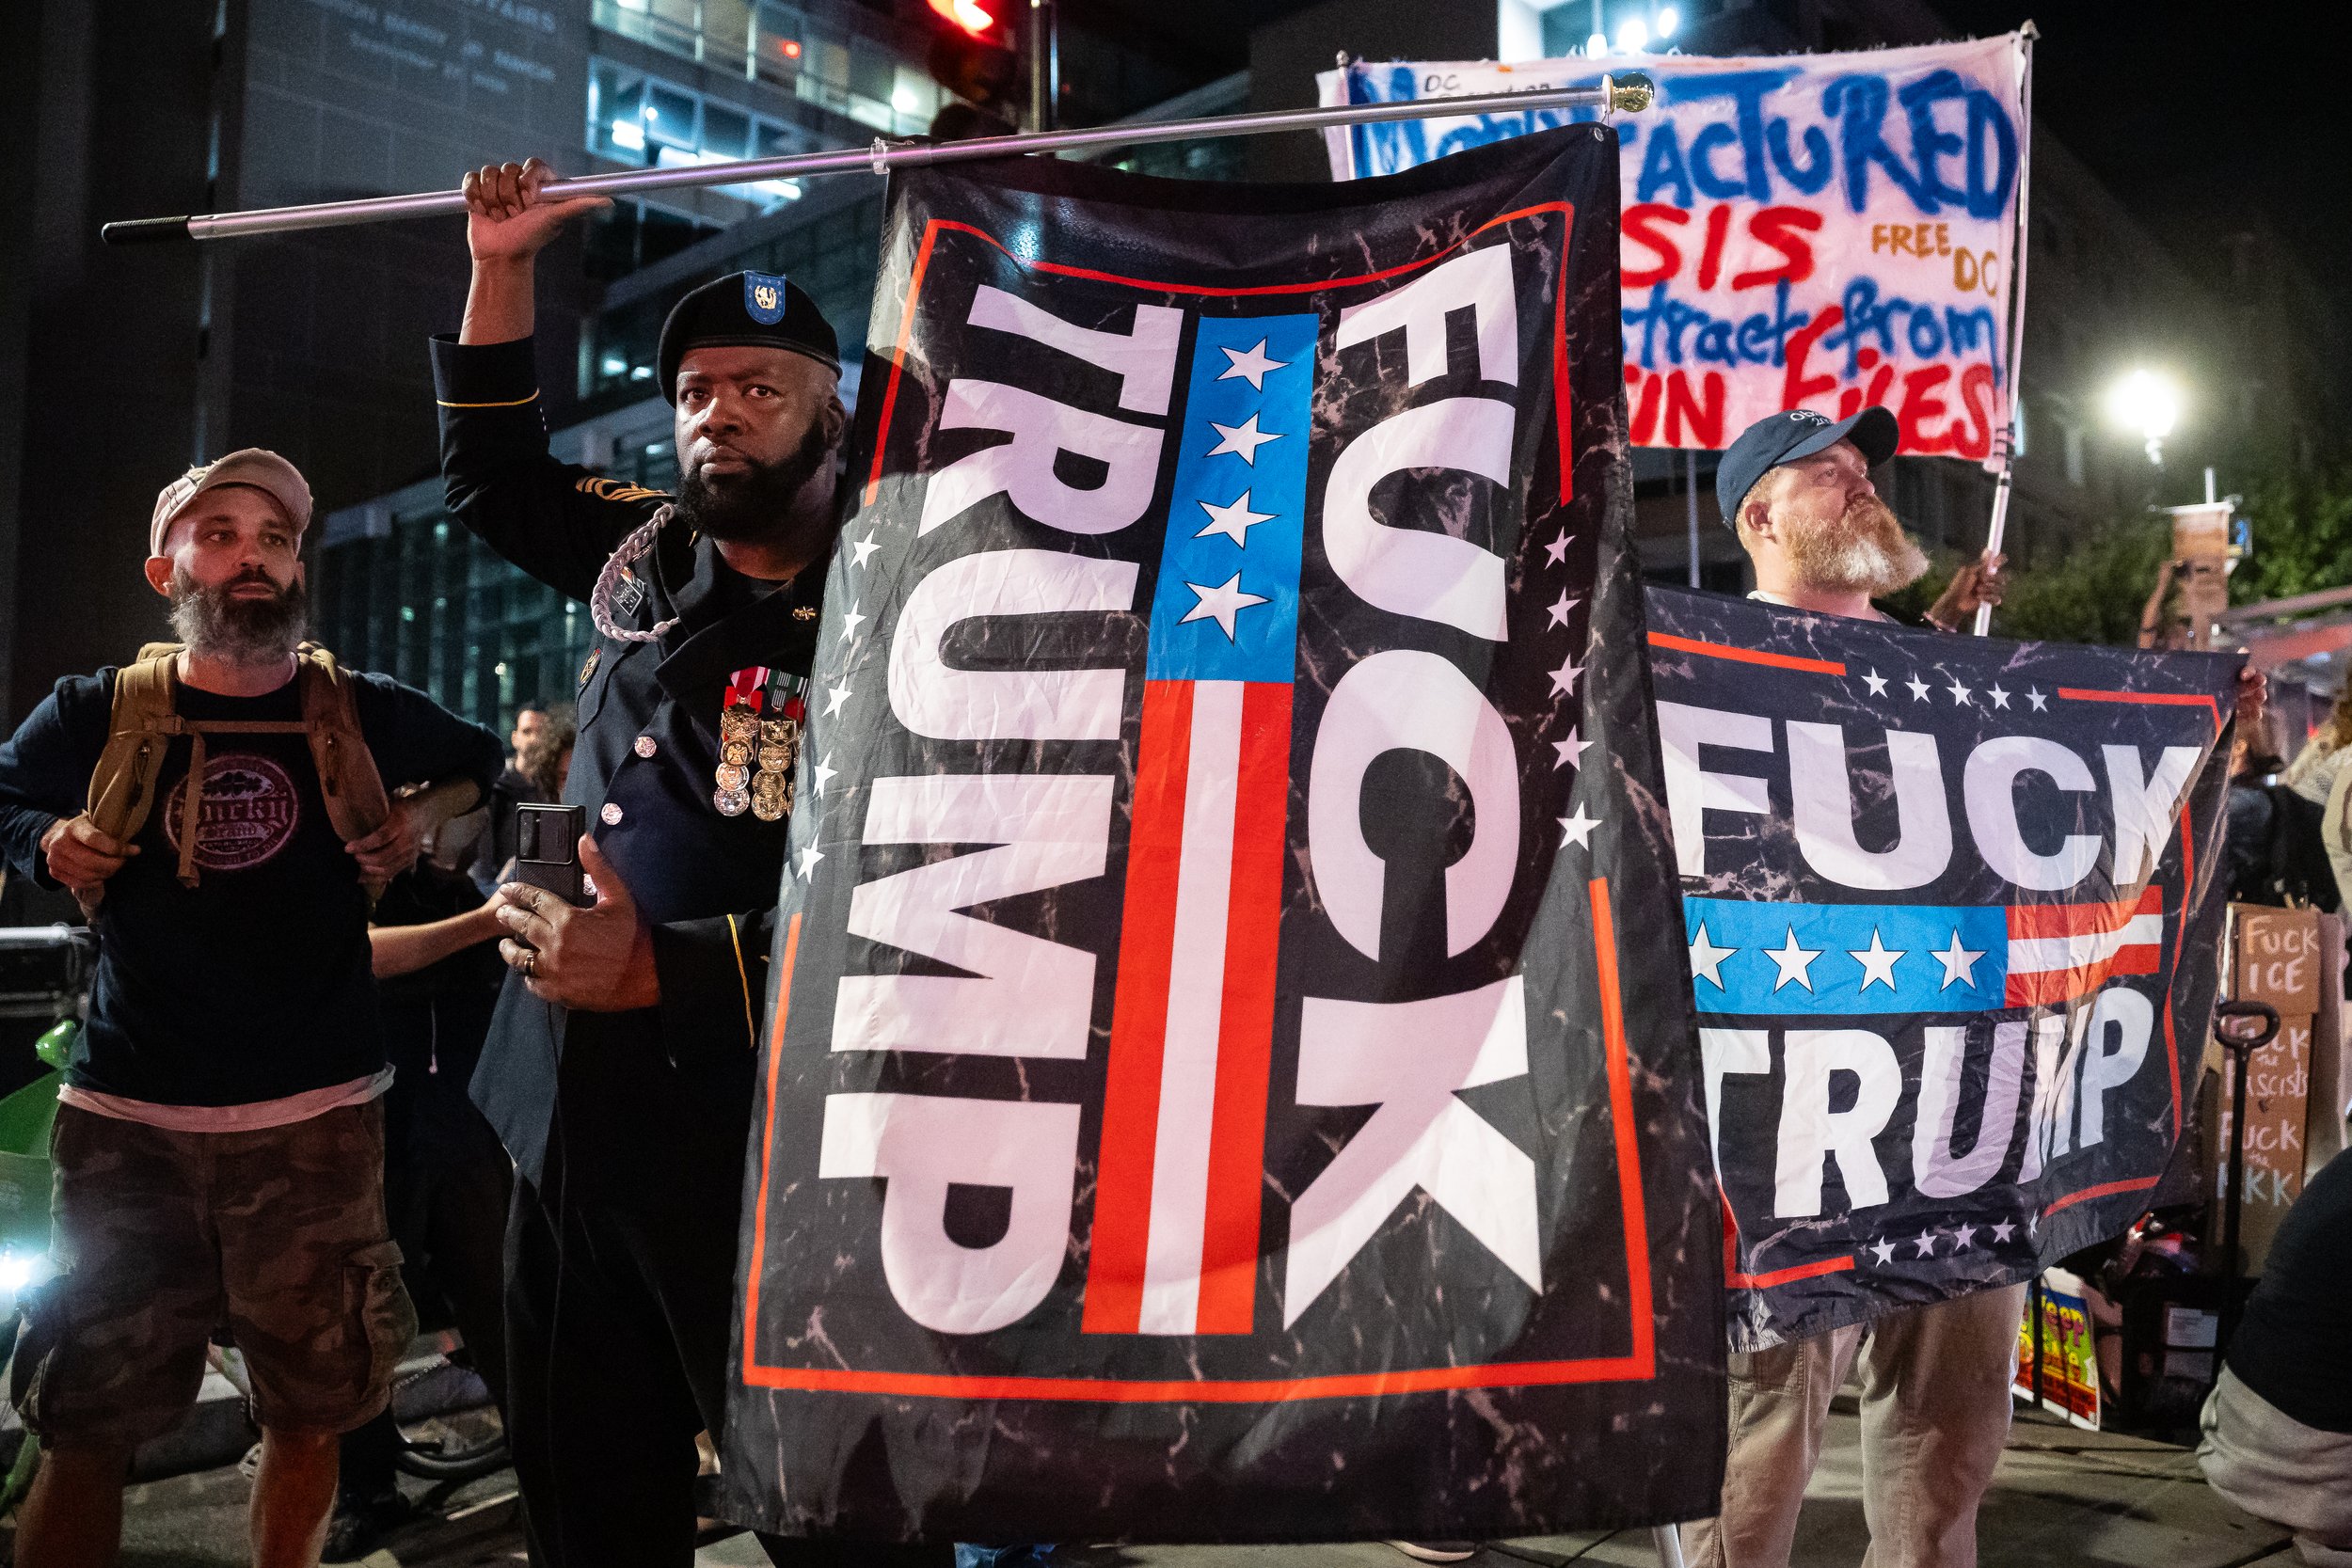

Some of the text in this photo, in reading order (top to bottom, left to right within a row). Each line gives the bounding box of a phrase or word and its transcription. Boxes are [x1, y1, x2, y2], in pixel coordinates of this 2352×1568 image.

[1424, 74, 1460, 92] DC
[1620, 203, 1823, 292] SIS
[1871, 222, 1951, 259] FREE
[1952, 246, 1998, 297] DC
[1621, 274, 2002, 388] tract from
[1625, 364, 1725, 449] IN
[818, 282, 1184, 1335] TRUMP
[1284, 241, 1545, 1333] FUCK
[1656, 700, 2202, 892] FUCK
[2249, 957, 2305, 994] ICE
[1698, 988, 2155, 1219] TRUMP
